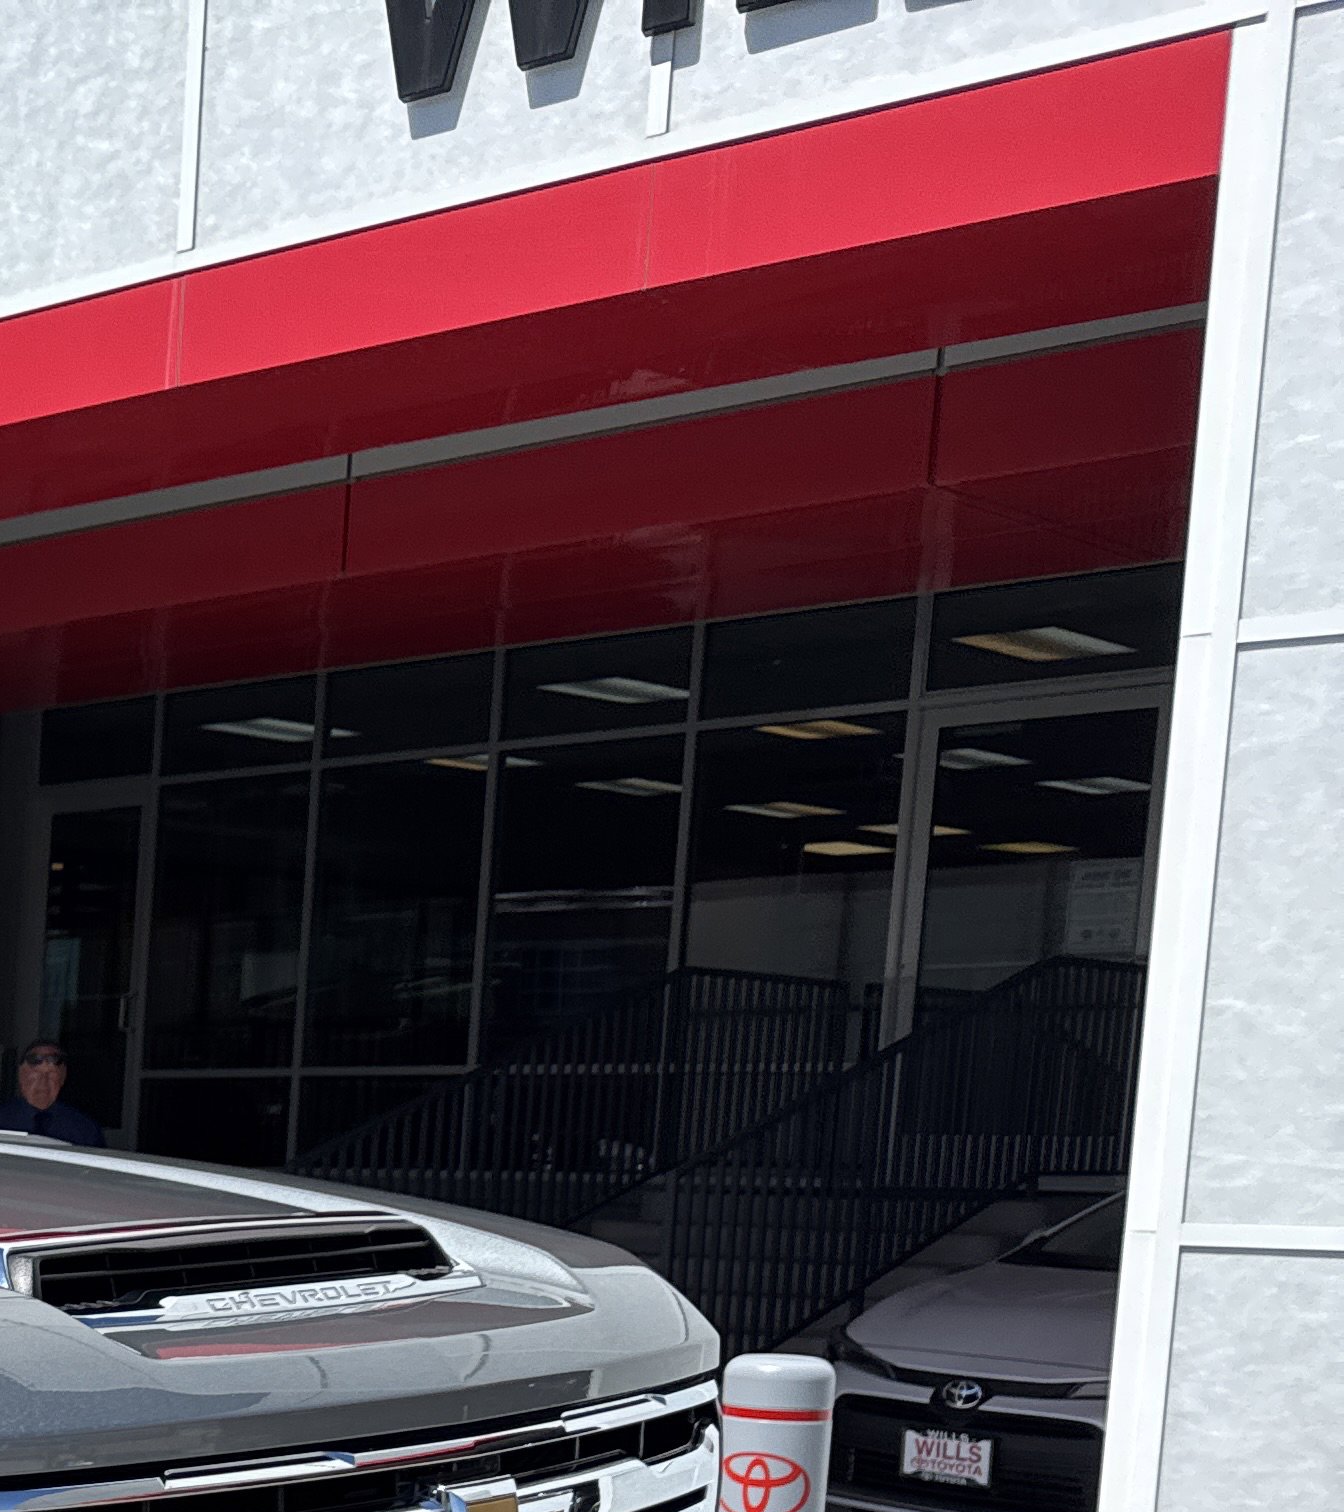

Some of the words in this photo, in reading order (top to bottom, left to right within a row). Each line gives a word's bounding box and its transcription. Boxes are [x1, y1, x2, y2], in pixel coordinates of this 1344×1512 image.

[205, 1280, 392, 1313] CHEVROLET
[914, 1438, 983, 1464] WILLS
[927, 1458, 983, 1477] TOYOTA
